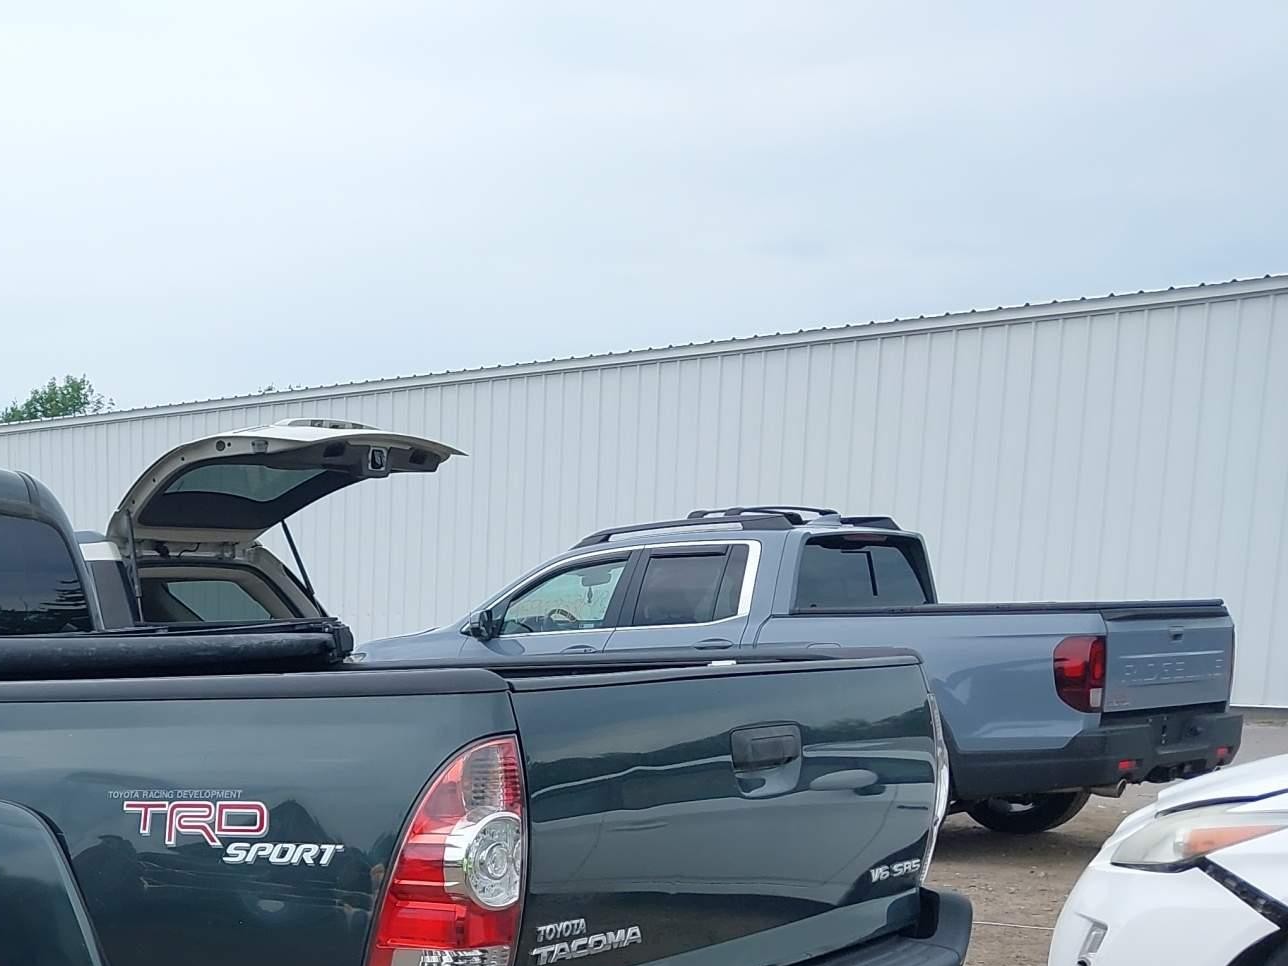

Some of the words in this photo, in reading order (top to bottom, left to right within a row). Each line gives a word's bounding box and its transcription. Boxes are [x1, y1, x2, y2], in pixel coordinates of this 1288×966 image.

[108, 789, 139, 799] TOYOTA
[142, 789, 173, 799] RACING
[176, 789, 243, 799] DEVELOPMENT
[122, 800, 270, 848] TRD
[222, 842, 345, 867] SPORT
[870, 865, 890, 883] V6
[536, 918, 587, 942] TOYOTA
[530, 925, 642, 966] TACOMA
